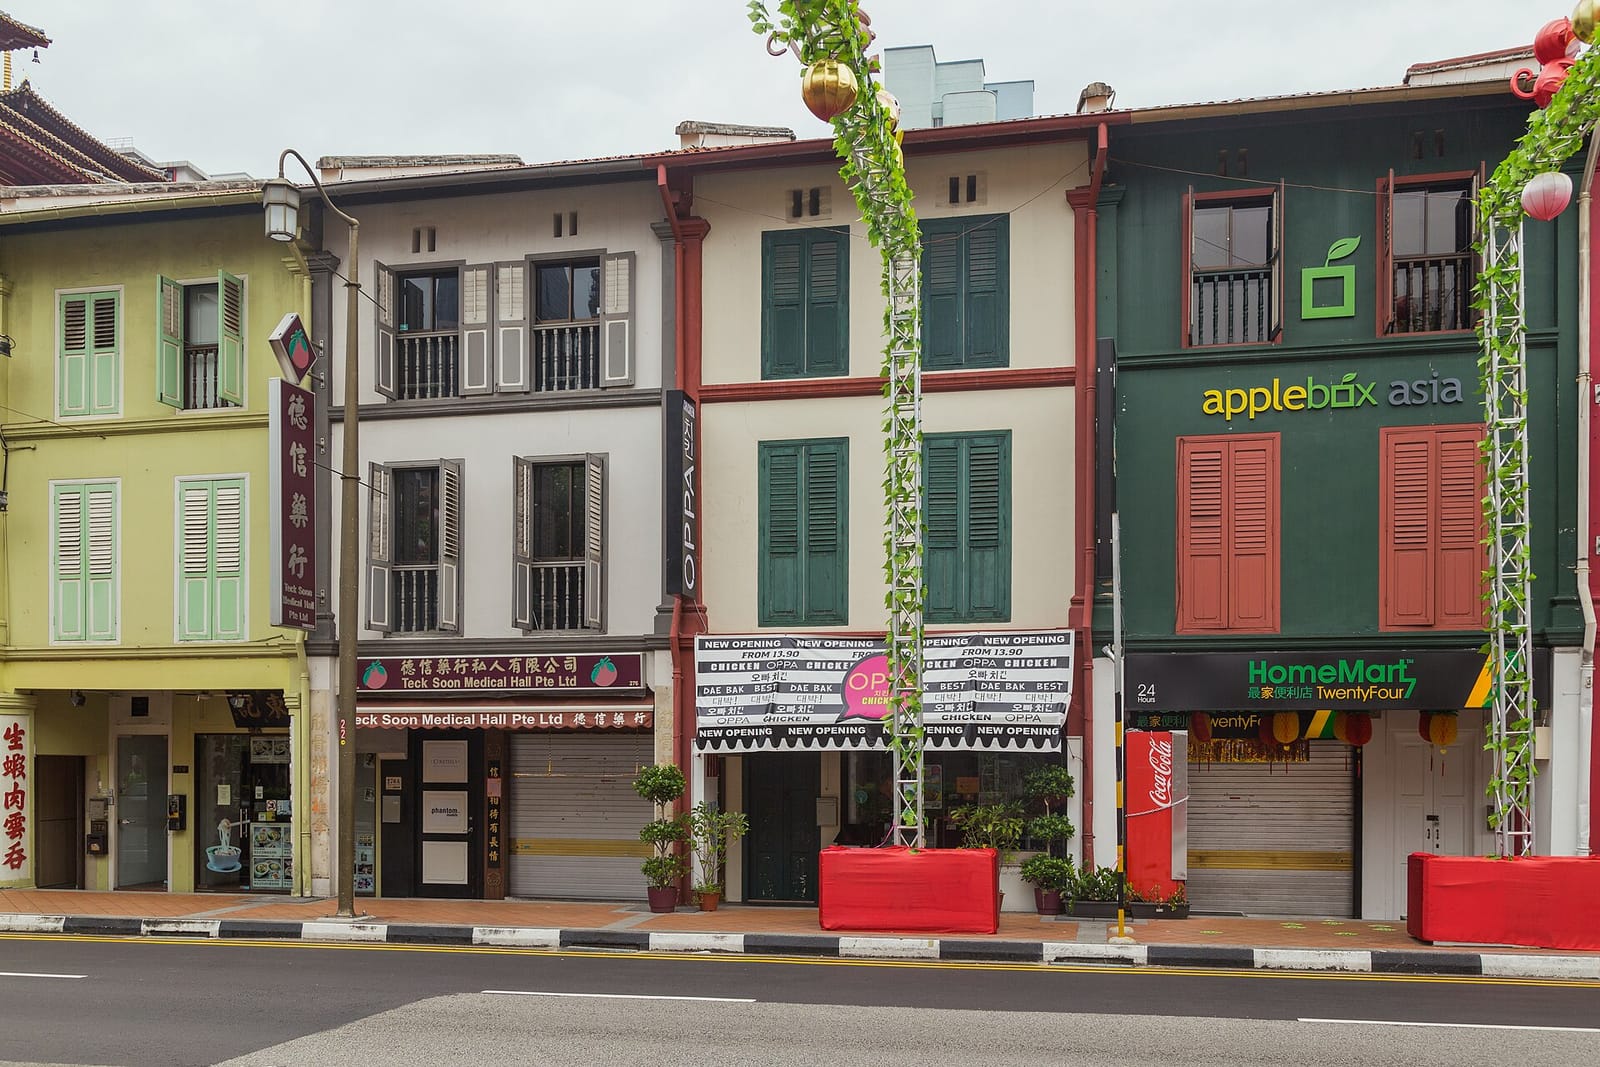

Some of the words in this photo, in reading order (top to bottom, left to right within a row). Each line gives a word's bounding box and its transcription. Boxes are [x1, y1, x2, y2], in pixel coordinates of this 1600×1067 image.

[1388, 371, 1463, 406] asia
[684, 465, 695, 590] OPPA
[284, 583, 297, 593] Teck
[298, 586, 313, 597] Soon
[282, 596, 303, 608] Medical
[303, 599, 315, 610] Hall
[288, 610, 298, 620] Pte
[299, 612, 309, 621] Ltd
[705, 641, 729, 649] NEW
[732, 640, 781, 648] OPENING
[796, 640, 822, 648] NEW
[824, 640, 874, 648] OPENING
[984, 637, 1010, 645] NEW
[1013, 635, 1065, 644] OPENING
[742, 651, 770, 659] FROM
[772, 650, 799, 658] 13.90
[994, 648, 1023, 656] 13.90
[711, 662, 760, 671] CHICKEN
[766, 660, 799, 669] OPPA
[963, 658, 998, 667] OPPA
[1004, 659, 1057, 667] CHICKEN
[402, 678, 428, 689] Teck
[432, 677, 460, 688] Soon
[464, 676, 507, 688] Medical
[510, 676, 531, 687] Hall
[535, 676, 554, 687] Pte
[558, 675, 577, 687] Ltd
[703, 687, 722, 695] DAE
[726, 686, 744, 694] BAK
[754, 683, 777, 692] BEST
[790, 684, 809, 692] DAE
[814, 684, 833, 692] BAK
[940, 682, 966, 690] BEST
[980, 682, 1000, 690] DAE
[1005, 682, 1026, 691] BAK
[1037, 682, 1064, 690] BEST
[1137, 684, 1156, 697] 24
[1248, 686, 1313, 699] 最家便利店
[356, 714, 378, 725] eck
[382, 714, 418, 725] Soon
[422, 714, 475, 725] Medical
[480, 714, 507, 725] Hall
[512, 714, 535, 725] Pte
[540, 714, 563, 725] Ltd
[717, 716, 750, 725] OPPA
[1005, 713, 1041, 722] OPPA
[699, 729, 723, 738] NEW
[726, 728, 773, 737] OPENING
[788, 727, 813, 735] NEW
[815, 726, 866, 735] OPENING
[978, 726, 1004, 735] NEW
[1006, 726, 1059, 735] OPENING
[1148, 735, 1173, 807] Coca-Cola
